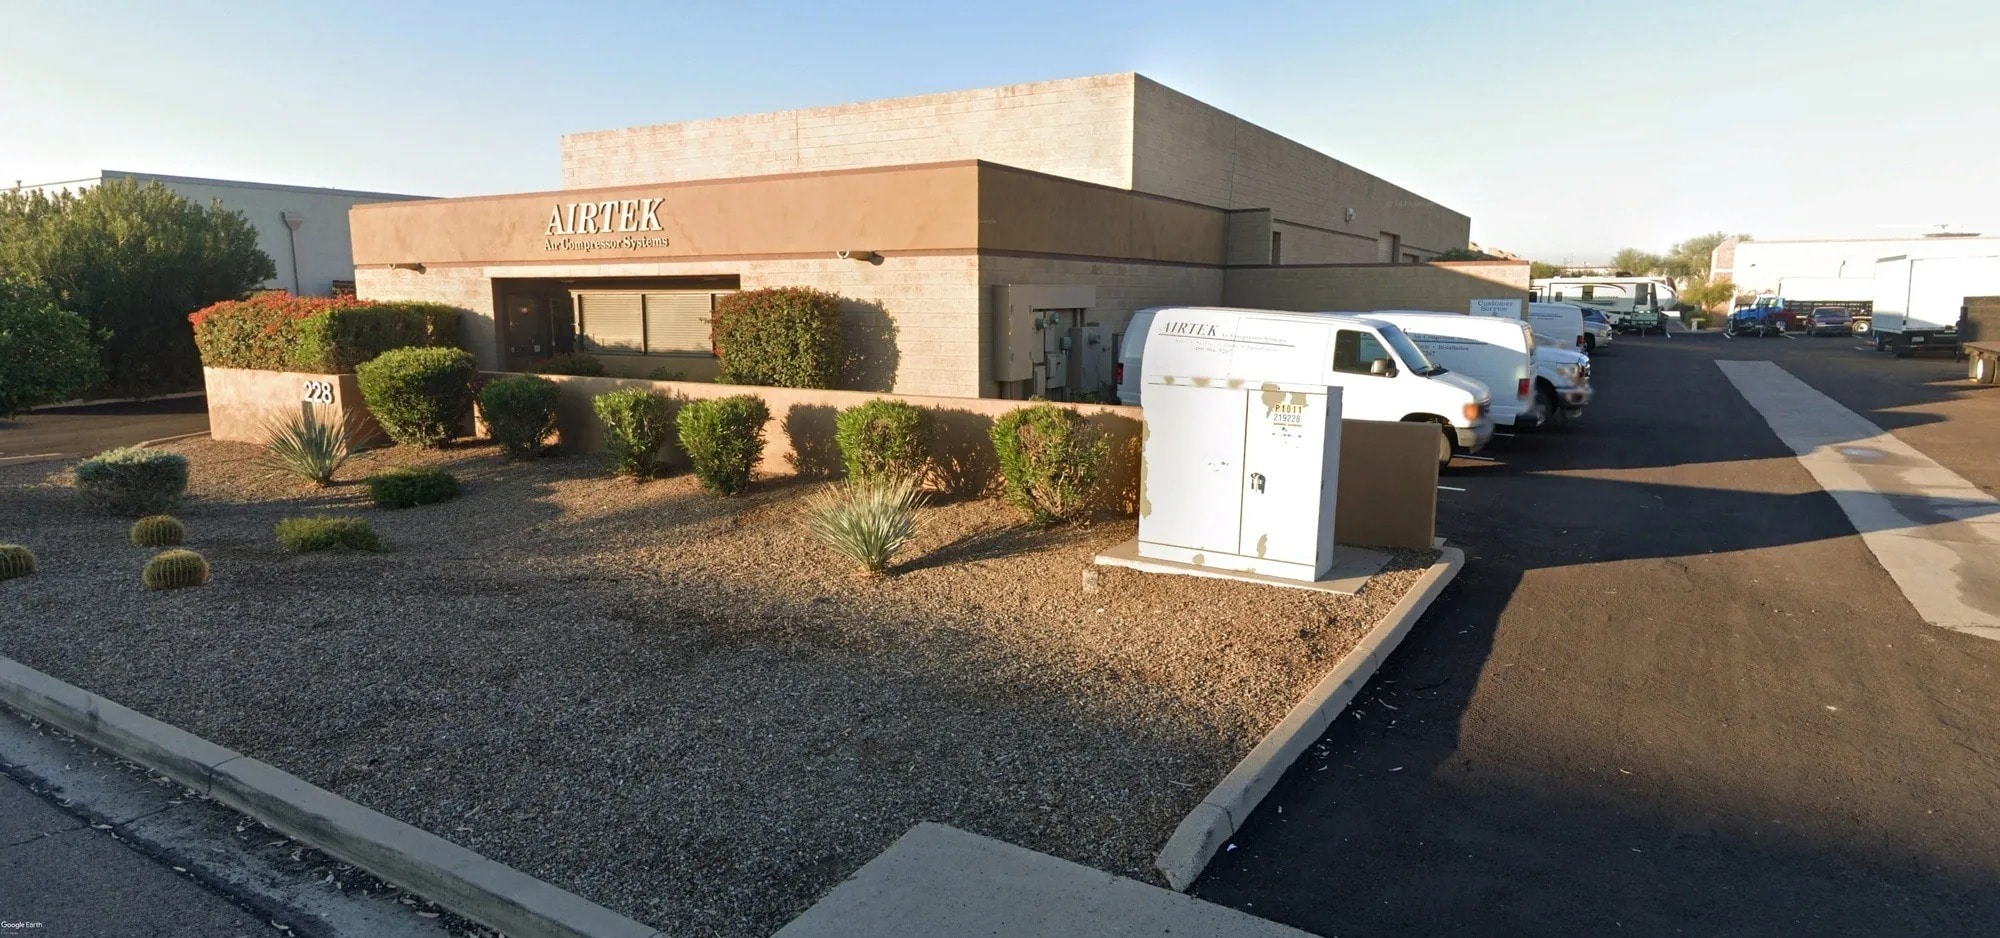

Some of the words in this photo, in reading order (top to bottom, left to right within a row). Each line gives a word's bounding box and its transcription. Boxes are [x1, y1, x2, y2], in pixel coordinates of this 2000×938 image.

[544, 198, 665, 236] AIRTEK
[544, 238, 559, 251] Air
[561, 238, 624, 252] Compressor
[624, 236, 669, 250] Systems
[1161, 320, 1219, 337] AIRTEK
[304, 380, 335, 404] 228
[1275, 404, 1302, 414] P1011
[1273, 413, 1301, 423] 219228
